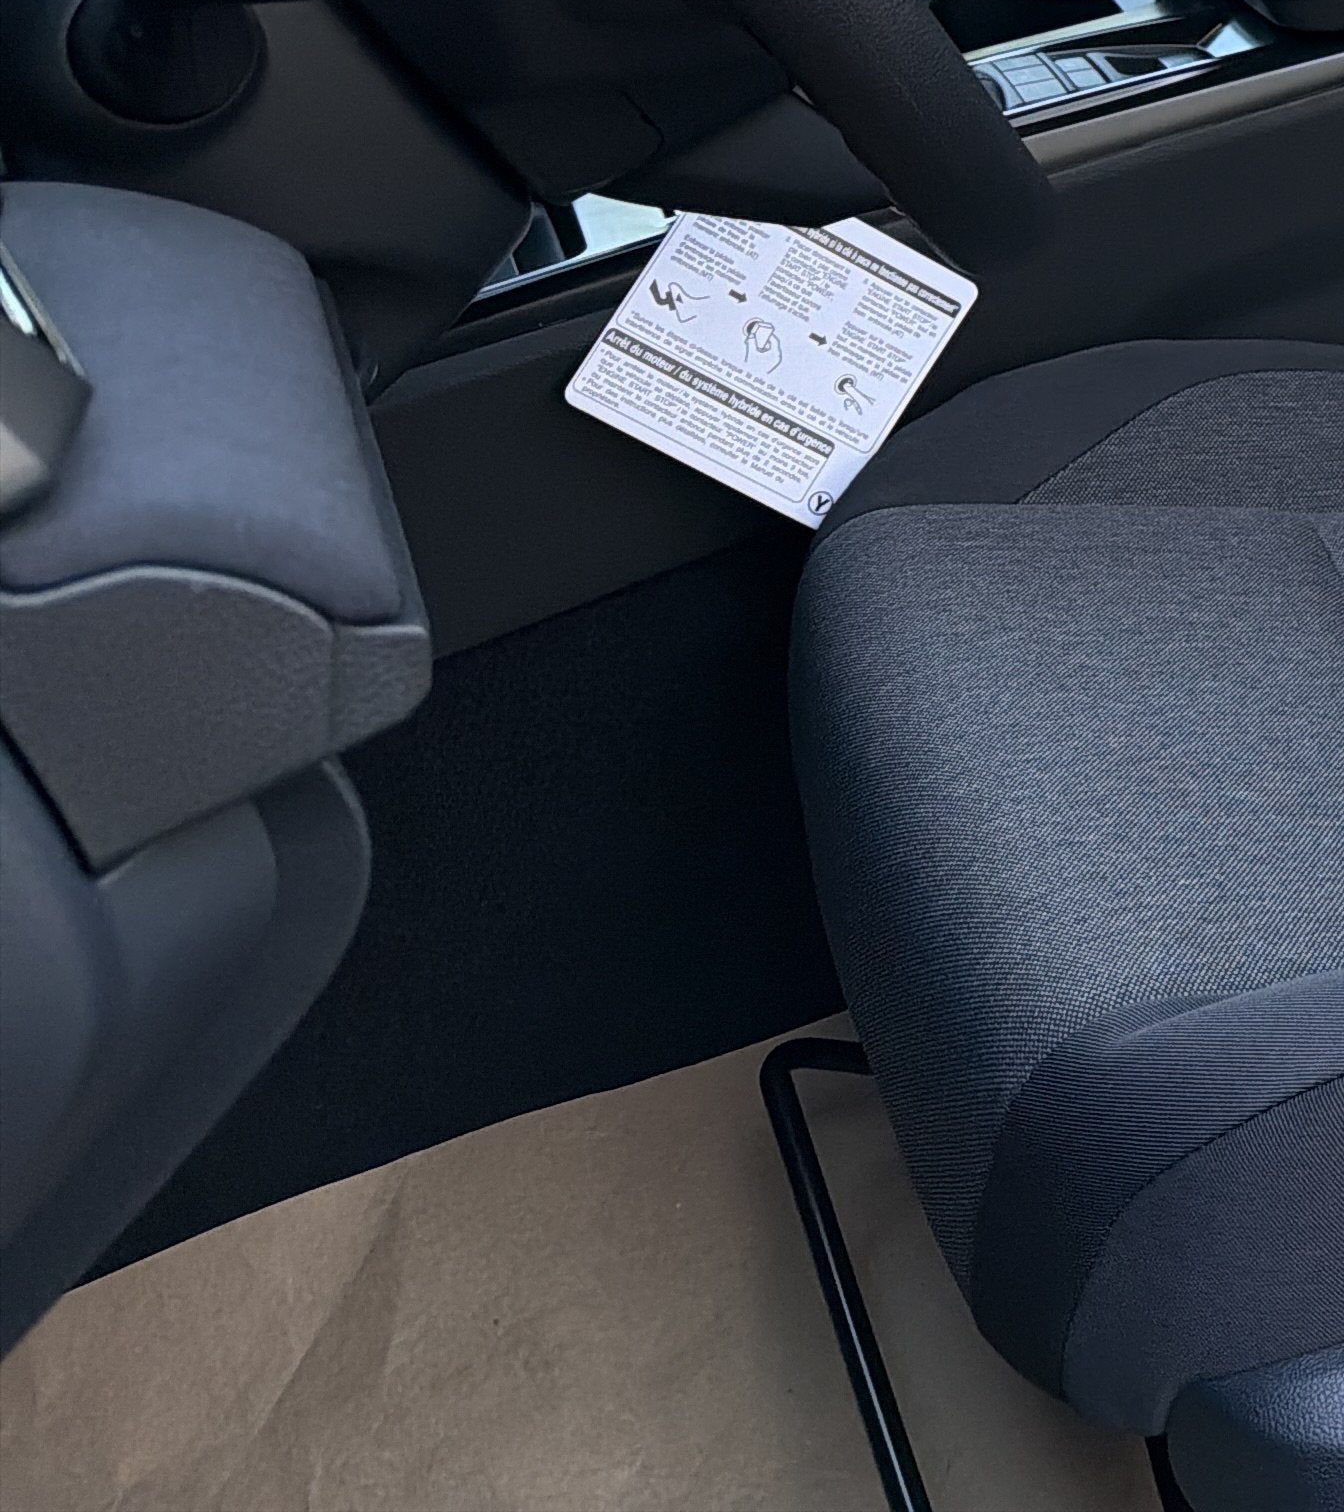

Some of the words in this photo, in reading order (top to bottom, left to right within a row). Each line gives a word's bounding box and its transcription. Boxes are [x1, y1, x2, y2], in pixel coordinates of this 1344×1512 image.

[627, 341, 646, 357] du
[640, 348, 676, 374] moteur
[676, 367, 695, 383] du
[688, 373, 731, 404] système
[725, 392, 765, 421] hybride
[759, 411, 775, 425] en
[771, 418, 791, 434] cas
[809, 493, 831, 514] Y
